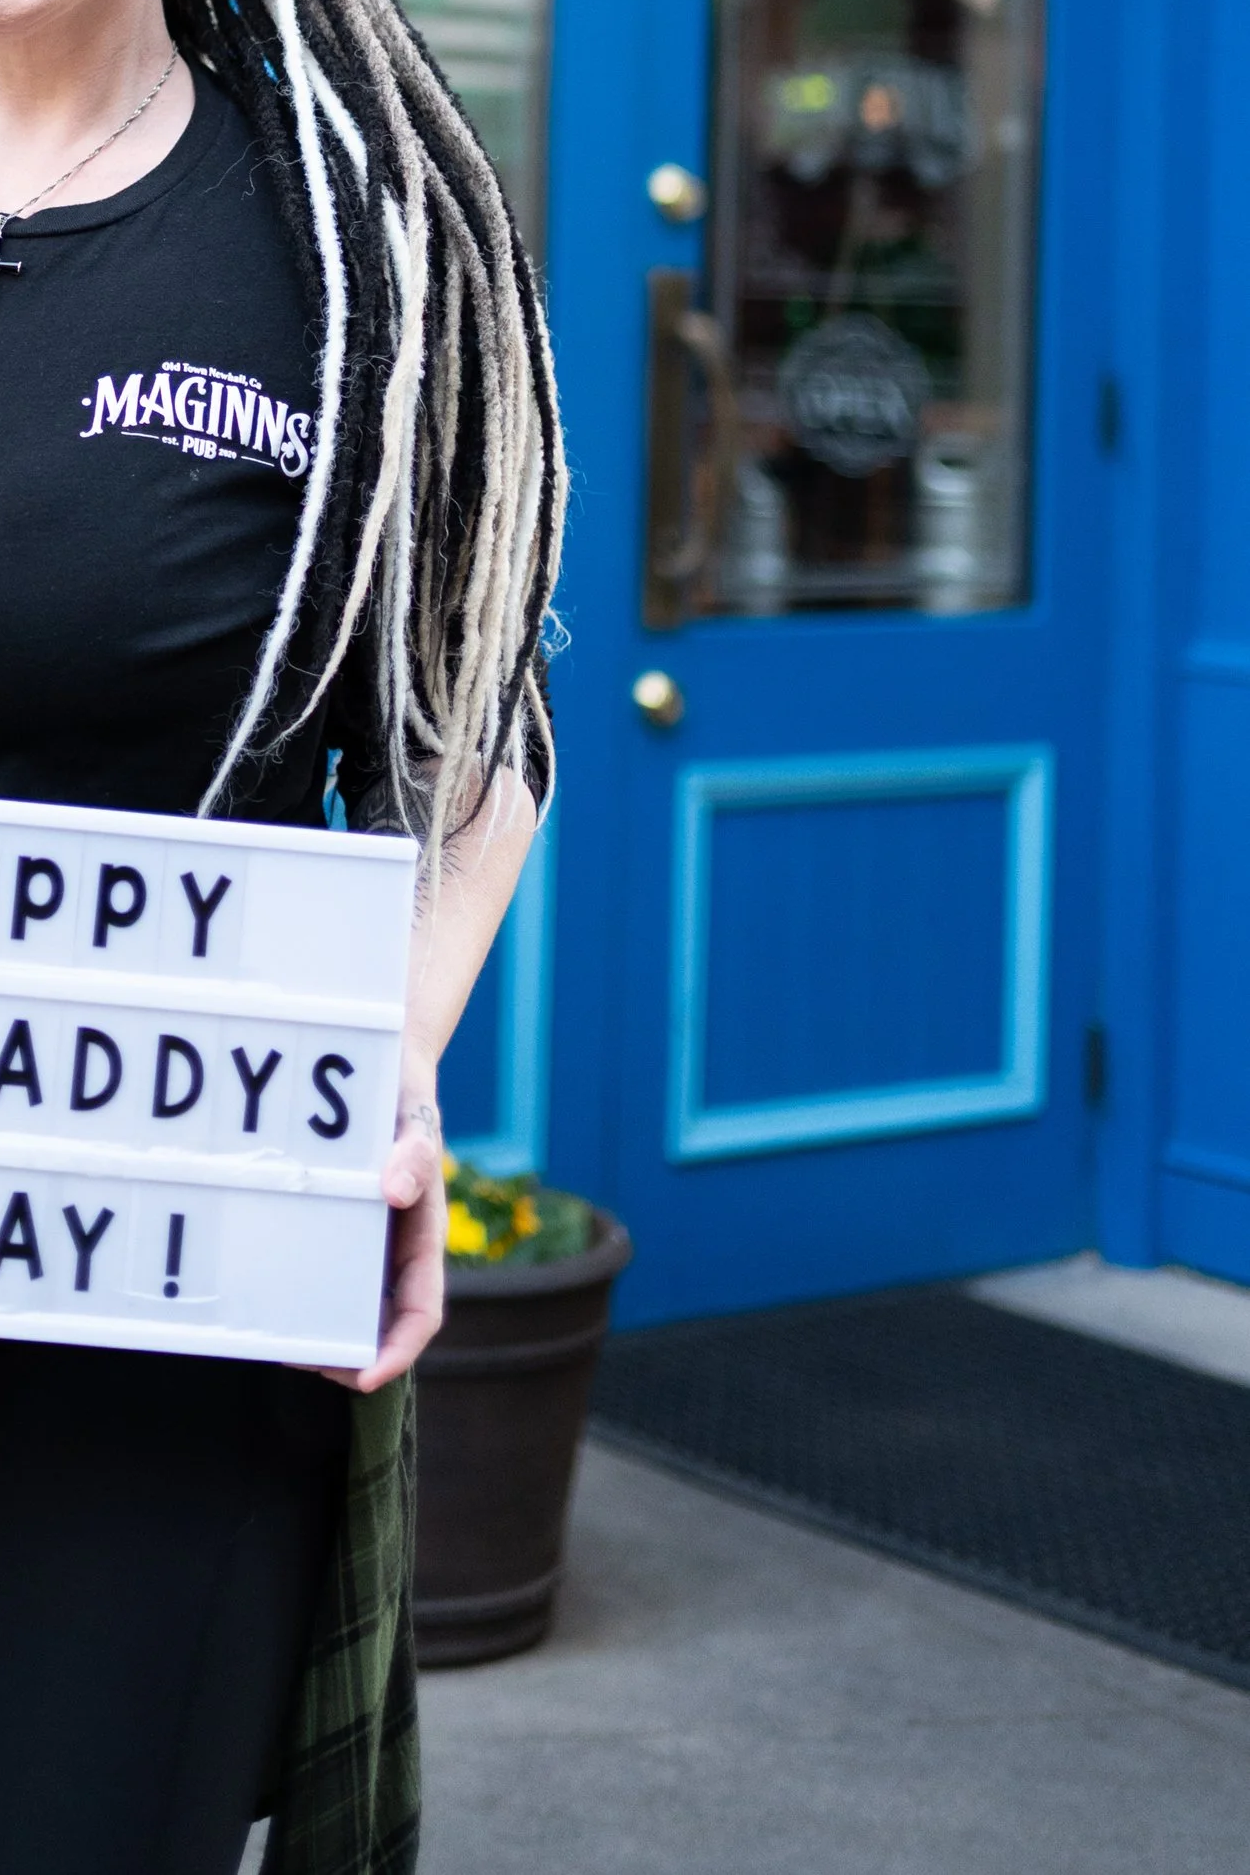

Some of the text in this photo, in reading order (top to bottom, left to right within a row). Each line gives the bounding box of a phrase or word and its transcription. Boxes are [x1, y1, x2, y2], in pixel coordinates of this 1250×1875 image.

[161, 361, 263, 391] Old Town Newhall, Ca
[161, 436, 180, 446] est.
[181, 434, 218, 460] PUB
